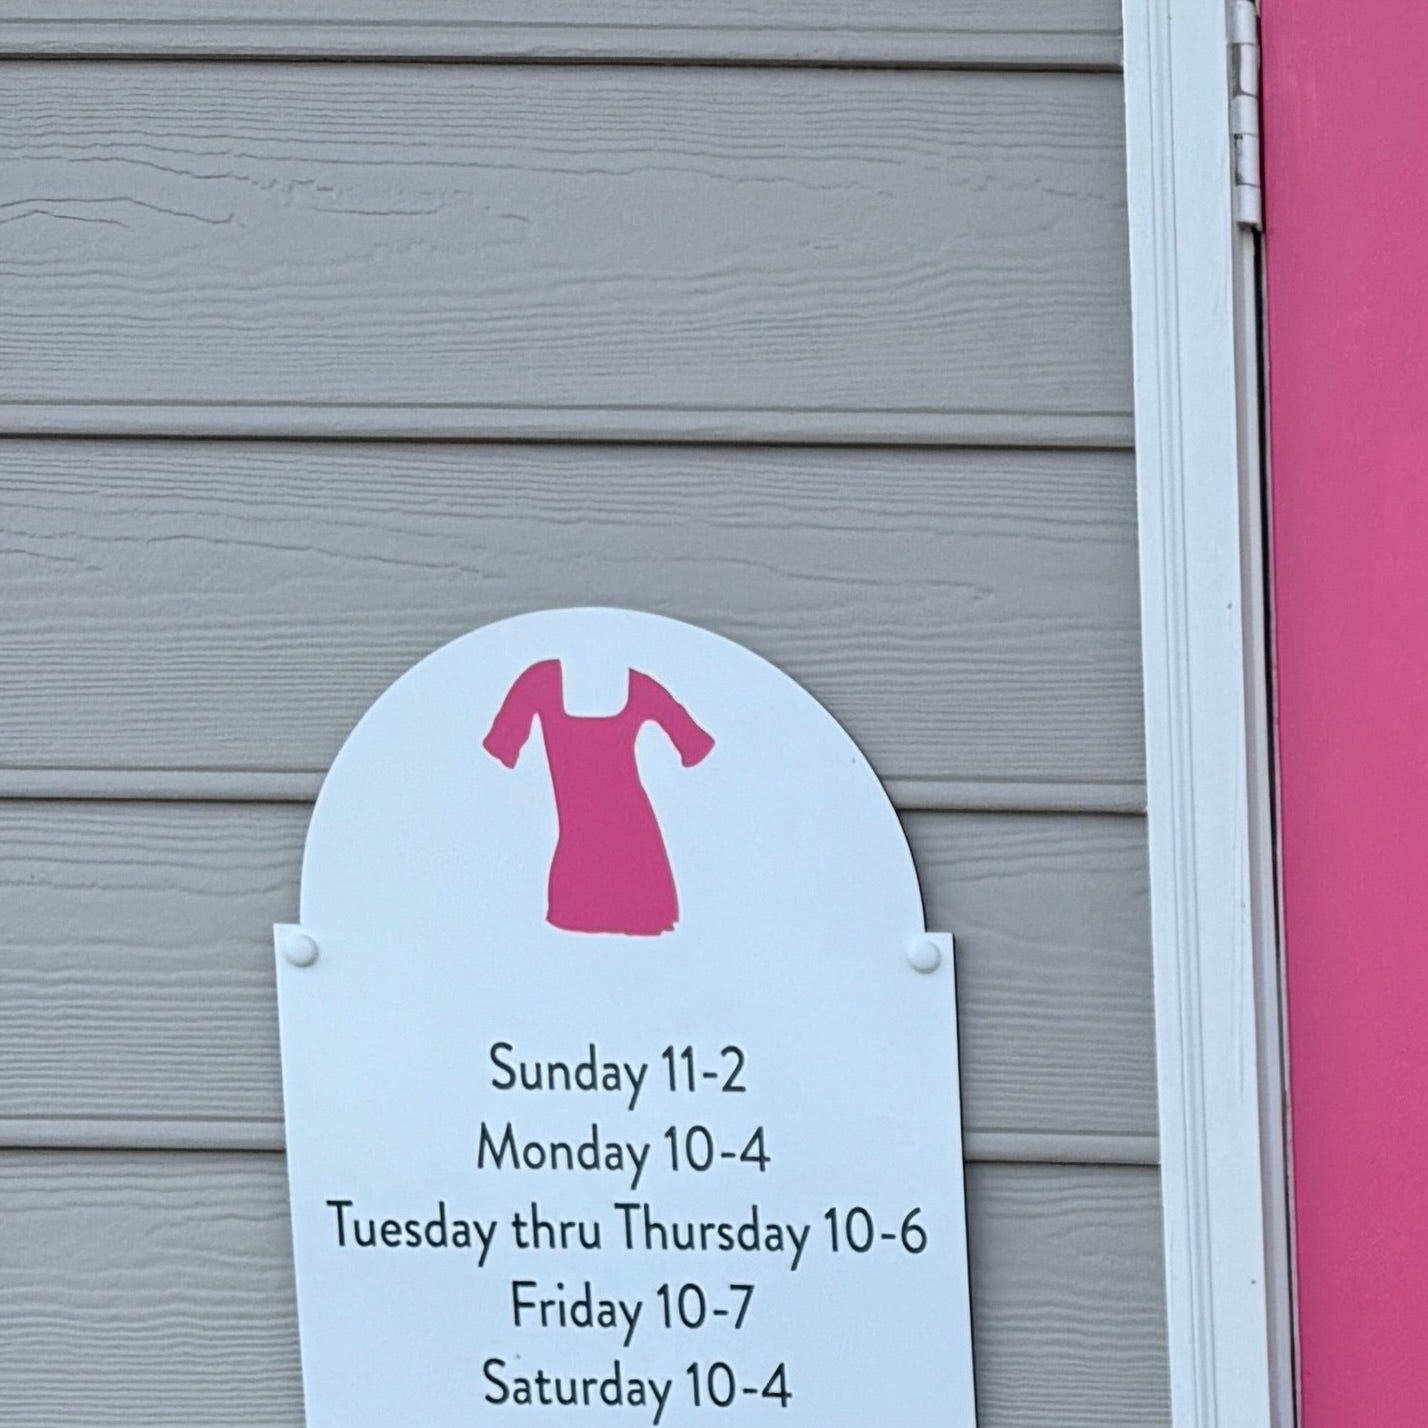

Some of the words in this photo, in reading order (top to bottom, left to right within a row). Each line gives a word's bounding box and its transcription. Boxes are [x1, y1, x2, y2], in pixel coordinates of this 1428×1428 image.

[490, 1041, 648, 1111] Sunday
[661, 1045, 746, 1093] 11-2
[477, 1121, 651, 1191] Monday
[664, 1125, 771, 1172] 10-4
[325, 1199, 498, 1268] Tuesday
[511, 1201, 601, 1250] thru
[613, 1202, 811, 1272] Thursday
[824, 1206, 927, 1254] 10-6
[511, 1280, 643, 1348] Friday
[656, 1282, 755, 1330] 10-7
[482, 1357, 673, 1426] Saturday
[686, 1361, 793, 1408] 10-4
